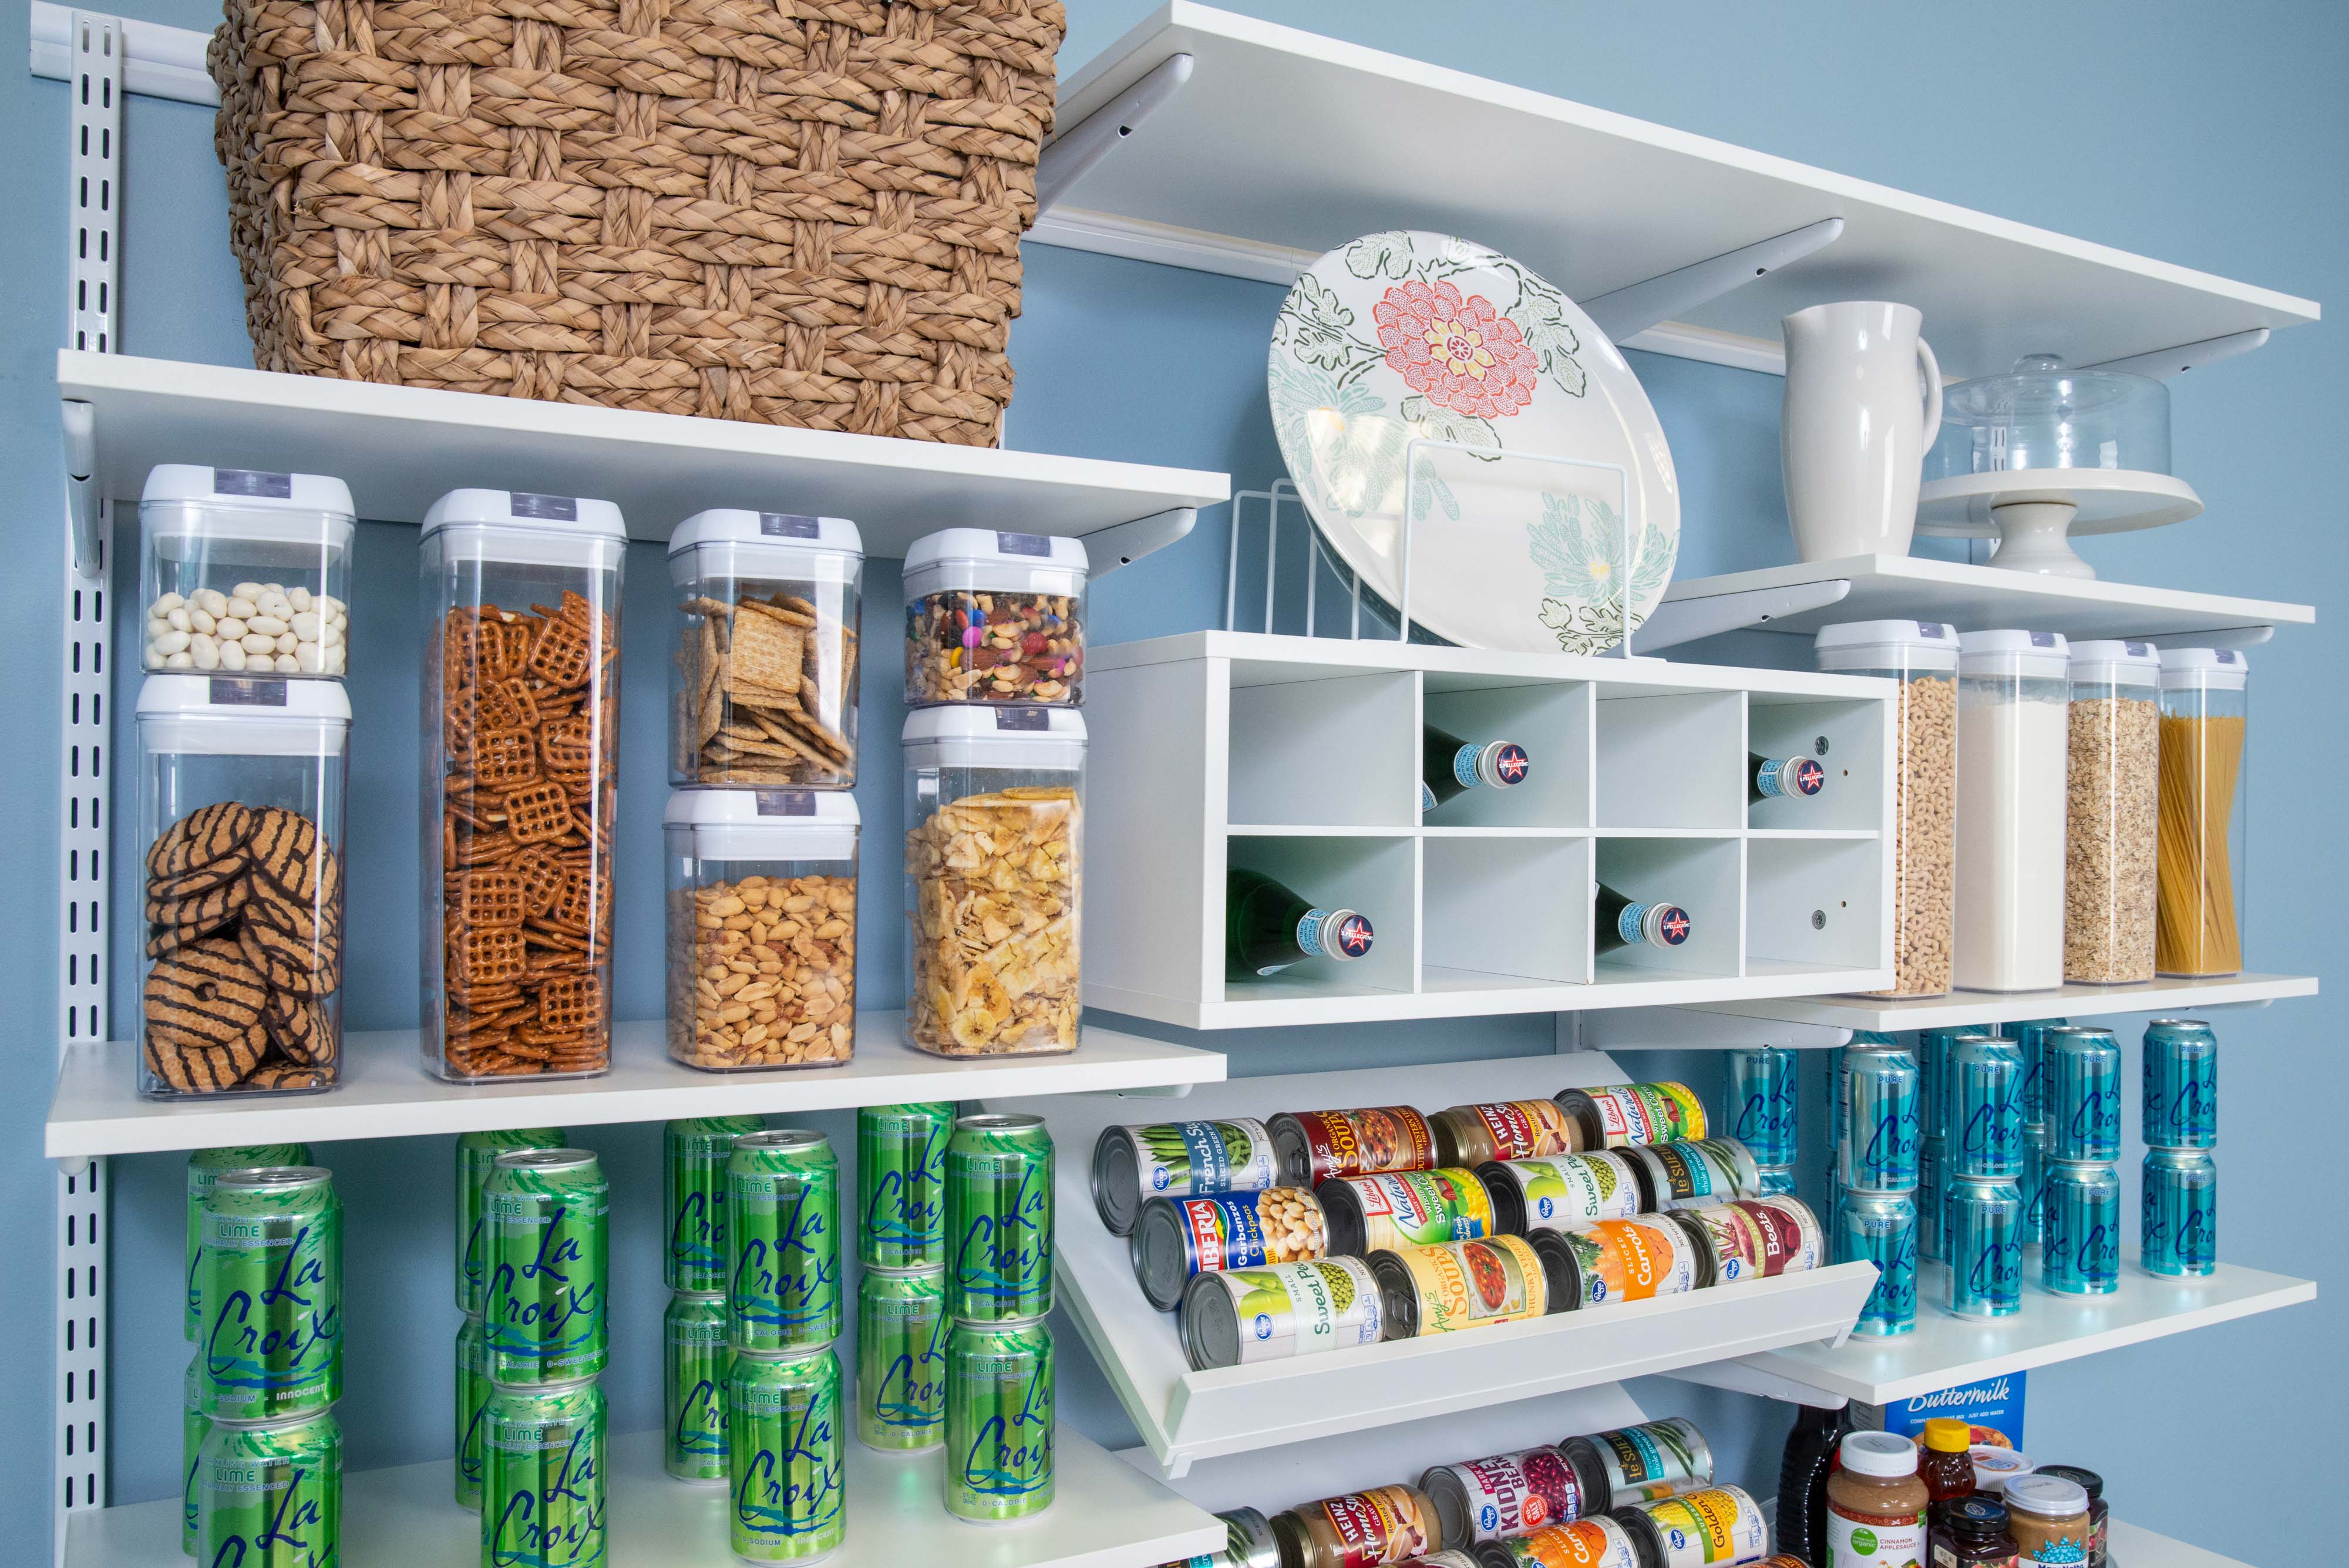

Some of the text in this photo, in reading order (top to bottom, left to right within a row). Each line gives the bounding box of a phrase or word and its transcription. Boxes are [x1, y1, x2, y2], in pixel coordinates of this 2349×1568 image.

[1341, 931, 1374, 941] S.PELLEGRINO
[1974, 1065, 2001, 1074] PURE
[2082, 1055, 2106, 1063] PURE
[1770, 1060, 1796, 1105] La
[1878, 1075, 1903, 1085] PURE
[1998, 1069, 2024, 1115] La
[1602, 1099, 1620, 1129] Libby's
[1610, 1088, 1644, 1145] Naturals
[1635, 1099, 1644, 1111] SUGAR
[1637, 1091, 1659, 1133] Whole Kernel
[1641, 1086, 1668, 1142] Sweet Corn
[877, 1120, 908, 1132] LIME
[1480, 1106, 1508, 1139] HEINZ
[1516, 1109, 1528, 1129] GRAVY
[1527, 1113, 1540, 1136] Roasted
[681, 1139, 712, 1152] LIME
[1210, 1131, 1222, 1154] GREEN
[1313, 1110, 1358, 1168] SOUPS
[1321, 1118, 1340, 1150] ORGANIC
[1407, 1119, 1424, 1170] OUTHWESTERN
[967, 1160, 1001, 1173] LIME
[1194, 1138, 1214, 1193] French
[1316, 1143, 1342, 1178] Amy's
[1157, 1169, 1167, 1189] Kroger
[1559, 1165, 1575, 1188] SMALL
[1690, 1153, 1709, 1193] whole green
[738, 1180, 772, 1193] LIME
[758, 1193, 799, 1202] ESSENCED
[1000, 1163, 1046, 1229] La
[1358, 1180, 1384, 1210] Libby's
[1579, 1170, 1598, 1216] Sweet
[2088, 1188, 2110, 1196] PURE
[491, 1202, 522, 1216] LIME
[1413, 1201, 1422, 1212] SALT
[1418, 1190, 1432, 1214] Whole
[1425, 1186, 1445, 1223] Sweet
[1981, 1206, 2007, 1214] PURE
[507, 1216, 552, 1224] ESSENCED
[773, 1184, 826, 1254] La
[1419, 1213, 1426, 1221] NO
[1864, 1220, 1891, 1229] PURE
[220, 1224, 260, 1239] LIME
[242, 1237, 293, 1247] ESSENCED
[1191, 1202, 1219, 1271] IBERIA
[1227, 1201, 1248, 1266] Garbanzos
[1242, 1204, 1260, 1257] Chickpeas
[1676, 1236, 1684, 1246] NET
[1756, 1212, 1779, 1257] Beets
[522, 1207, 583, 1282] La
[956, 1214, 1052, 1284] Croix
[1617, 1237, 1634, 1274] SLICED
[1622, 1226, 1652, 1286] Carrots
[1890, 1223, 1917, 1271] La
[260, 1226, 326, 1306] La
[732, 1237, 836, 1312] Croix
[1357, 1266, 1366, 1276] NET
[1728, 1261, 1738, 1277] Kroger
[1285, 1274, 1301, 1302] SMALL
[1419, 1247, 1467, 1316] SOUPS
[1429, 1259, 1449, 1297] ORGANIC
[483, 1263, 595, 1341] Croix
[1526, 1271, 1536, 1317] CHUNKY
[1595, 1282, 1605, 1301] Kroger
[887, 1304, 920, 1315] LIME
[971, 1299, 1015, 1308] 0-CALORIE
[1307, 1280, 1330, 1335] Sweet
[1425, 1290, 1455, 1332] Amy's
[208, 1290, 337, 1375] Croix
[688, 1328, 721, 1341] LIME
[745, 1327, 792, 1337] 0-CALORIE
[1260, 1316, 1269, 1337] Kroger
[978, 1361, 1013, 1373] LIME
[211, 1394, 257, 1404] 0-SODIUM
[745, 1391, 781, 1404] LIME
[1012, 1360, 1050, 1426] La
[765, 1403, 806, 1413] ESSENCED
[504, 1428, 543, 1441] LIME
[782, 1393, 833, 1463] La
[892, 1428, 933, 1438] 0-CALORIE
[526, 1440, 573, 1451] ESSENCED
[965, 1415, 1055, 1485] Croix
[1642, 1437, 1661, 1476] whole green
[250, 1456, 291, 1468] WATER
[543, 1428, 597, 1503] La
[1561, 1462, 1570, 1472] NET
[216, 1469, 257, 1483] LIME
[237, 1480, 290, 1492] ESSENCED
[738, 1449, 842, 1522] Croix
[1476, 1469, 1492, 1490] DARK
[255, 1469, 322, 1550] La
[982, 1498, 1027, 1506] 0-CALORIE
[1529, 1502, 1541, 1520] SALT
[1536, 1499, 1544, 1516] ADDED
[1330, 1503, 1359, 1542] HEINZ
[1365, 1503, 1381, 1526] GRAVY
[1379, 1507, 1394, 1533] Roasted
[1483, 1508, 1495, 1528] Kroger
[1526, 1509, 1532, 1519] NO
[1698, 1500, 1725, 1548] Golden
[492, 1489, 605, 1568] Croix
[1673, 1531, 1682, 1547] Kroger
[742, 1536, 781, 1546] 0-SODIUM
[1544, 1529, 1570, 1554] SLICED
[1852, 1539, 1876, 1549] organic
